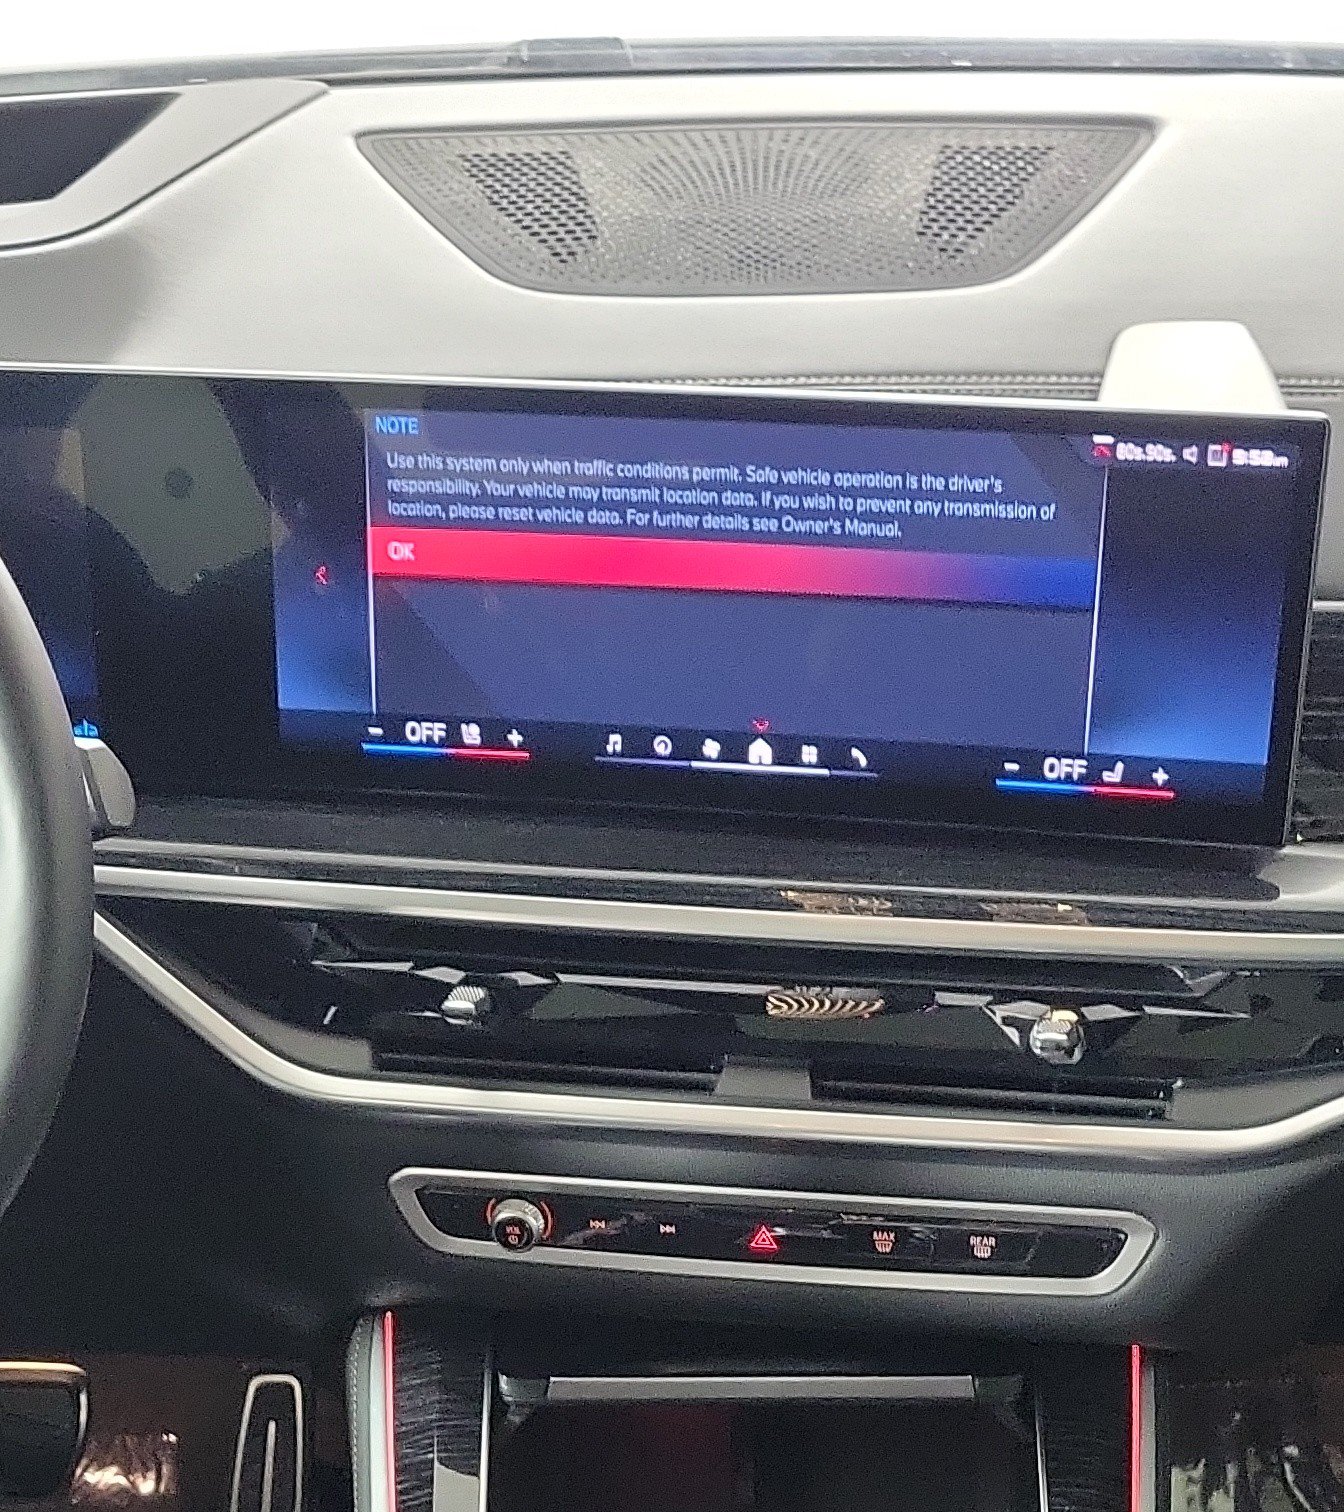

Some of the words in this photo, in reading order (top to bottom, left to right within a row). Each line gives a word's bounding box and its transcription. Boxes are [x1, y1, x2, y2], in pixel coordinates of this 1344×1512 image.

[375, 416, 419, 435] NOTE
[386, 452, 414, 469] Use
[417, 453, 443, 471] this
[446, 456, 496, 475] system
[499, 457, 529, 477] only
[532, 459, 571, 475] when
[574, 459, 613, 477] traffic
[616, 462, 688, 481] conditions
[746, 465, 778, 484] Safe
[781, 469, 830, 486] vehicle
[834, 471, 903, 492] operation
[906, 472, 918, 490] is
[921, 473, 945, 491] the
[949, 474, 1003, 493] driver's
[387, 479, 479, 499] responsibility.
[483, 481, 515, 498] Your
[517, 481, 566, 499] vehicle
[569, 485, 599, 503] may
[602, 484, 660, 502] transmit
[663, 487, 719, 505] location
[722, 490, 758, 507] data.
[761, 492, 773, 507] If
[773, 494, 798, 512] you
[802, 493, 836, 510] wish
[839, 495, 854, 511] to
[856, 498, 911, 518] prevent
[914, 500, 943, 519] any
[944, 499, 1037, 520] transmission
[1040, 502, 1057, 521] of
[387, 500, 446, 520] location,
[449, 503, 495, 523] please
[498, 504, 533, 521] reset
[536, 506, 584, 524] vehicle
[587, 506, 623, 525] data.
[626, 508, 650, 526] For
[653, 510, 700, 528] further
[703, 511, 749, 531] details
[752, 516, 778, 532] see
[782, 516, 841, 535] Owner's
[845, 518, 902, 538] Manual.
[387, 541, 415, 561] OK
[405, 720, 447, 745] OFF
[1043, 756, 1088, 781] OFF
[872, 1230, 895, 1242] MAX
[969, 1235, 996, 1247] REAR
